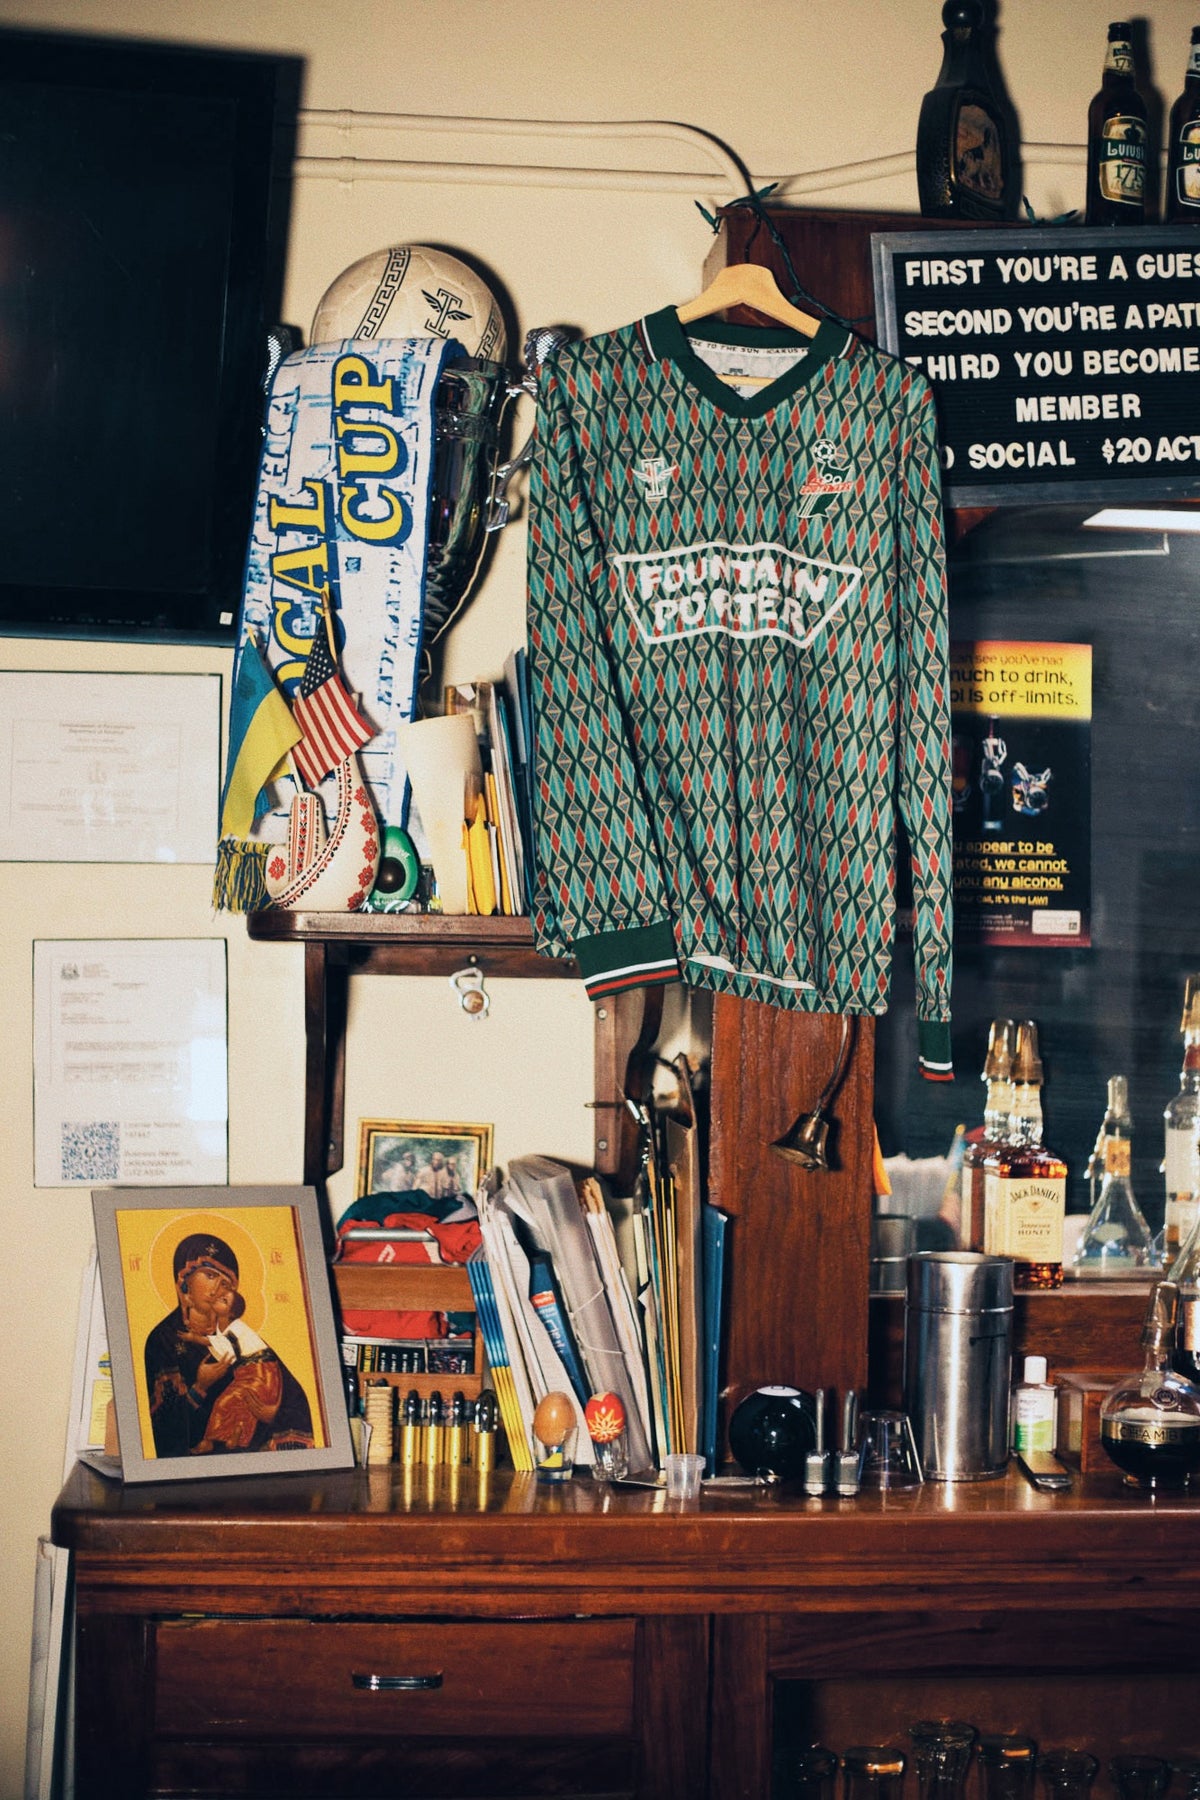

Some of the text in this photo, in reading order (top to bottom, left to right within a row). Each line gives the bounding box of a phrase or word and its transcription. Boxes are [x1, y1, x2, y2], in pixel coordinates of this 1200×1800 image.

[905, 259, 985, 286] FIRST
[996, 254, 1098, 284] YOU'RE
[1108, 255, 1129, 282] A
[904, 308, 1013, 337] SECOND
[1017, 301, 1117, 333] YOU'RE
[1124, 303, 1145, 330] A
[1014, 350, 1073, 378] YOU
[1083, 347, 1200, 376] BECOME
[1015, 393, 1142, 423] MEMBER
[332, 353, 412, 546] CUP
[968, 439, 1076, 469] SOCIAL
[1101, 436, 1152, 465] $20
[639, 554, 829, 601] FOUNTAIN
[655, 587, 807, 638] PORTER
[1000, 669, 1019, 683] to
[1024, 670, 1073, 687] drink,
[969, 688, 984, 703] is
[989, 689, 1079, 705] off-limits.
[1018, 841, 1034, 853] to
[1036, 841, 1054, 853] be
[994, 860, 1016, 871] we
[1018, 859, 1067, 871] cannot
[983, 876, 1009, 889] any
[1120, 1425, 1179, 1442] CHAMB
